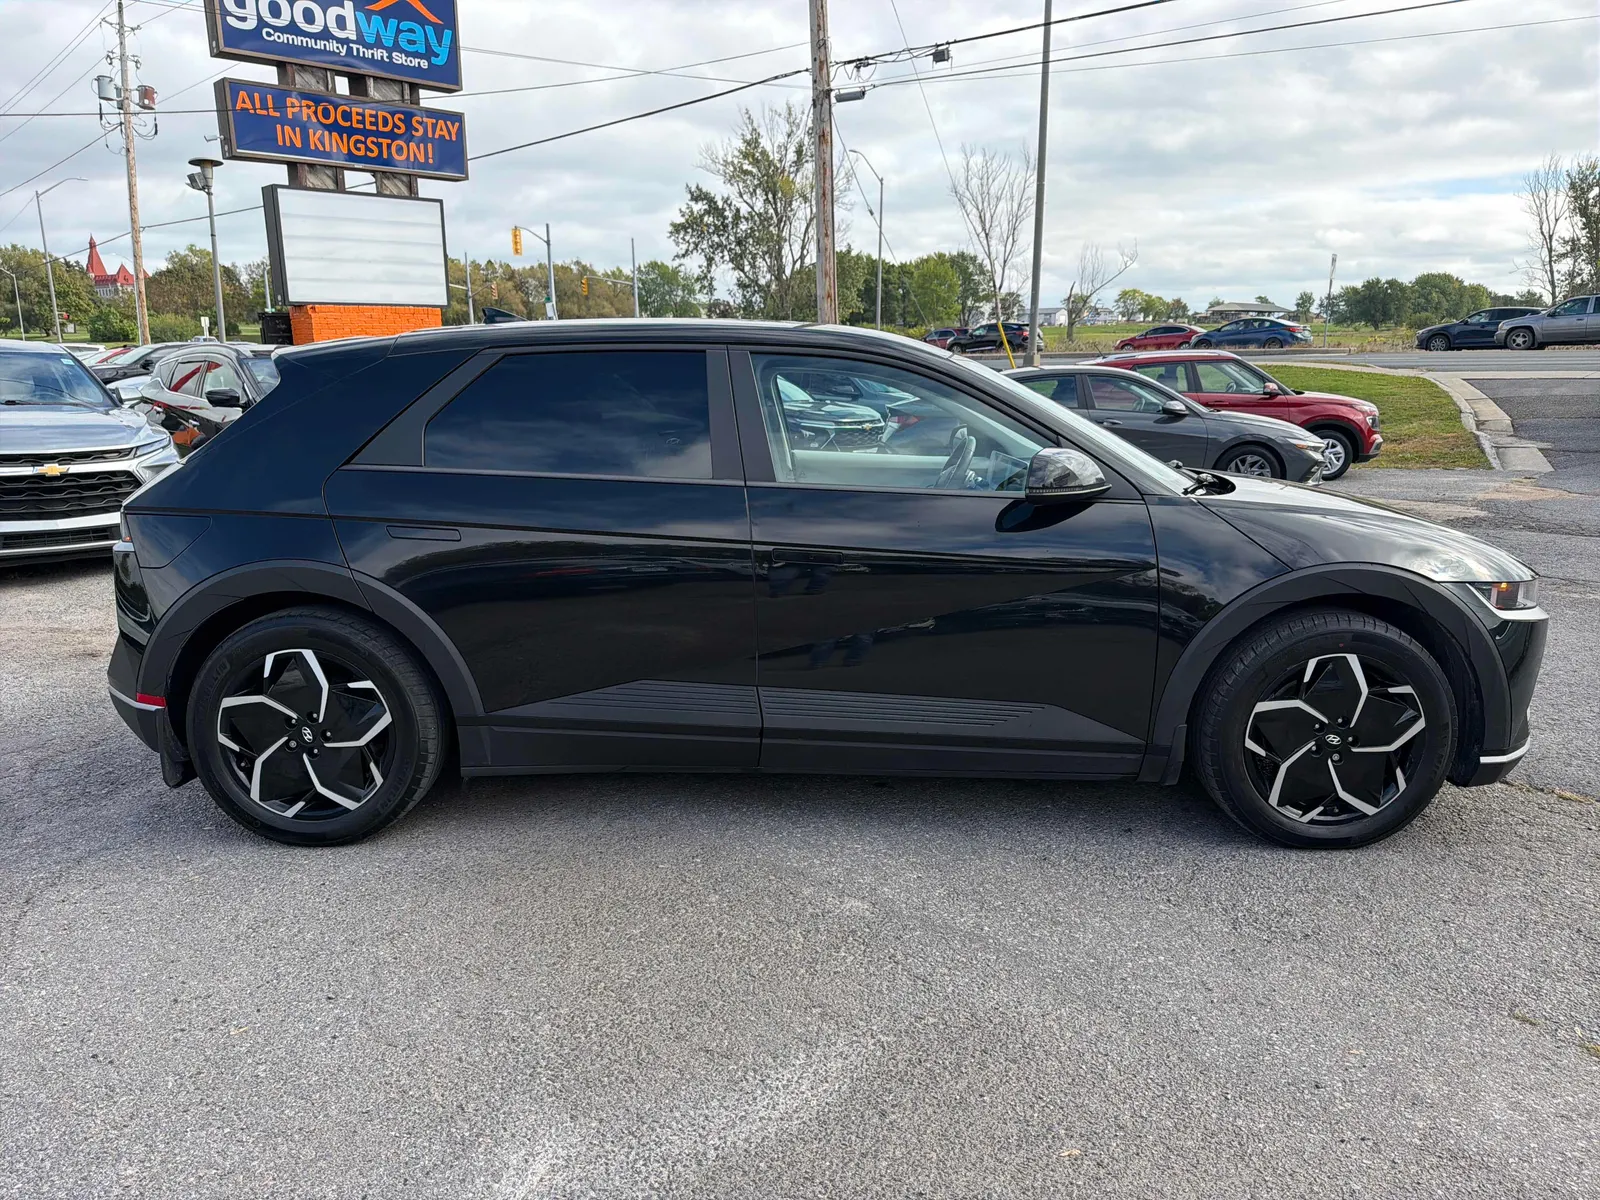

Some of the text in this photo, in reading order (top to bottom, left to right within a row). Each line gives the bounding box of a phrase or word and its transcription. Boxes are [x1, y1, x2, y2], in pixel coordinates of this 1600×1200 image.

[224, 0, 452, 65] goodway
[262, 28, 429, 69] Community Thrift Store
[235, 90, 460, 141] ALL PROCEEDS STAY
[276, 124, 434, 164] IN KINGSTON!
